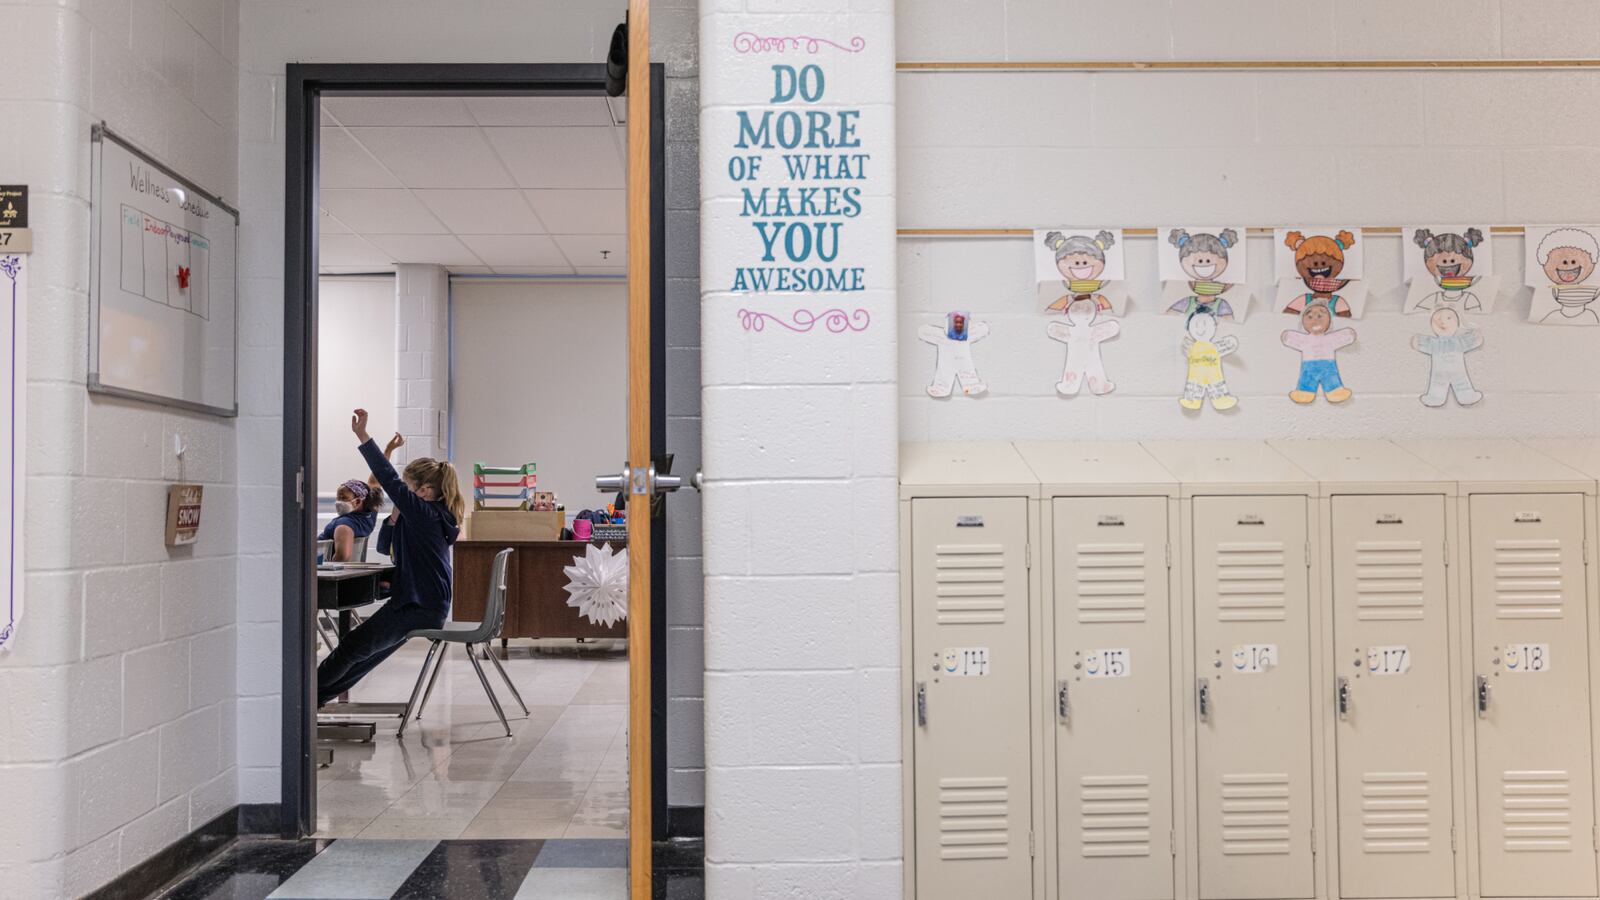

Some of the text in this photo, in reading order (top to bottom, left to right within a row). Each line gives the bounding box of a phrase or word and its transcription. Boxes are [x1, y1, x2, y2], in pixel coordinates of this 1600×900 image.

[770, 64, 825, 103] DO
[734, 110, 861, 149] MORE
[728, 154, 870, 181] OF WHAT
[129, 161, 170, 204] Wellness
[739, 187, 862, 217] MAKES
[0, 232, 13, 246] 7
[752, 221, 843, 263] YOU
[731, 267, 865, 292] AWESOME
[179, 509, 200, 525] SNOW
[963, 650, 987, 676] 14
[1104, 650, 1125, 676] 15
[1252, 646, 1270, 670] 16
[1384, 649, 1407, 672] 17
[1524, 646, 1544, 671] 18
